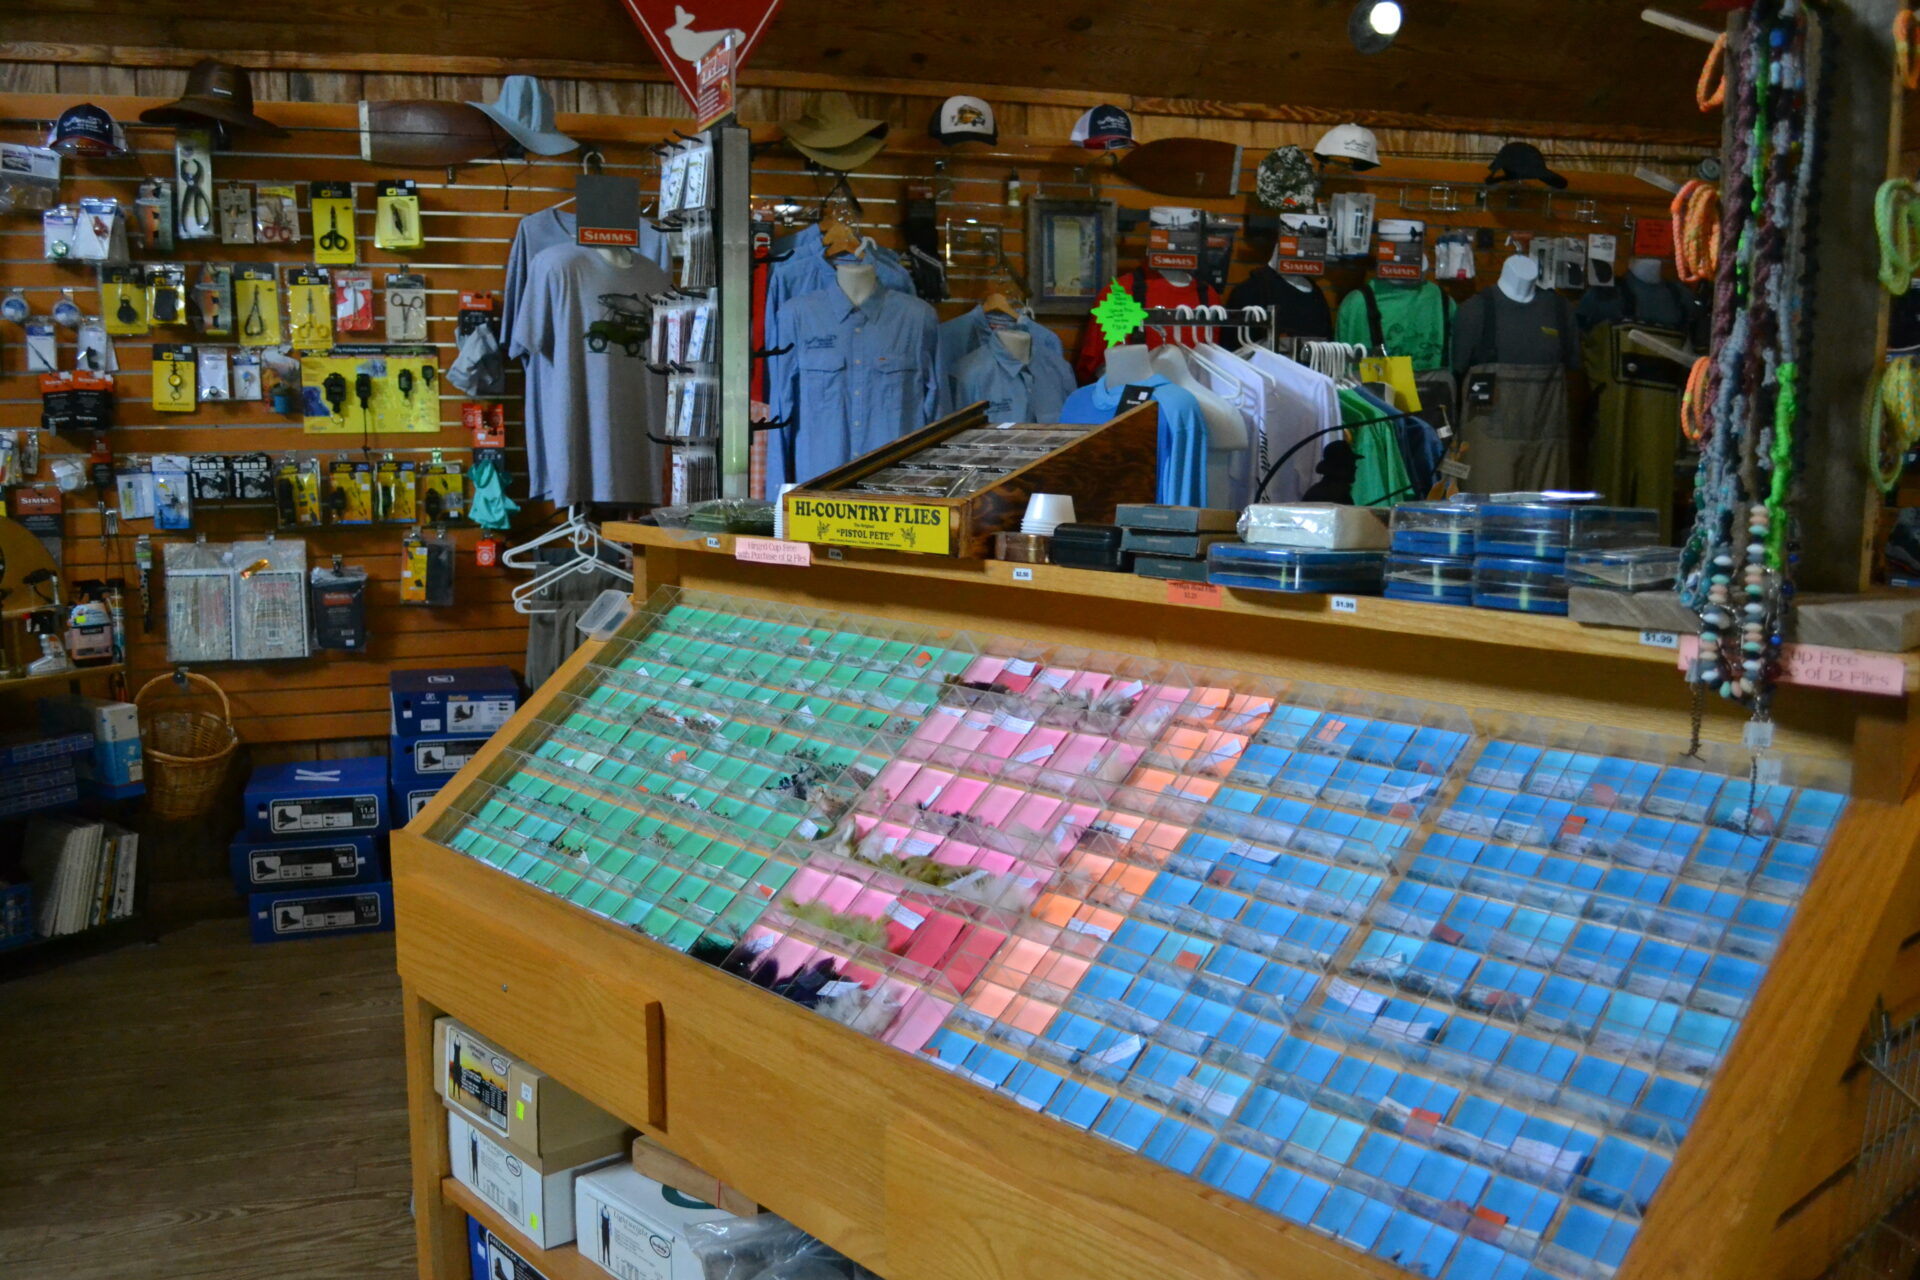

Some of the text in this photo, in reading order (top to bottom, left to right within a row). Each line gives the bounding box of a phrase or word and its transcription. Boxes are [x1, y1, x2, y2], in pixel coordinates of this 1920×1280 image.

[583, 230, 633, 242] SIMMS
[1153, 255, 1193, 265] SIMMS
[1282, 262, 1320, 271] SIMMS
[1381, 266, 1417, 276] SIMMS
[20, 496, 56, 505] SIMMS
[795, 500, 941, 526] HI-COUNTRY FLIES
[1335, 600, 1354, 609] $1.99
[1644, 632, 1673, 645] $1.99
[1819, 652, 1856, 666] Free
[1804, 667, 1822, 681] of
[1828, 669, 1843, 682] 12
[1849, 671, 1889, 686] Flies
